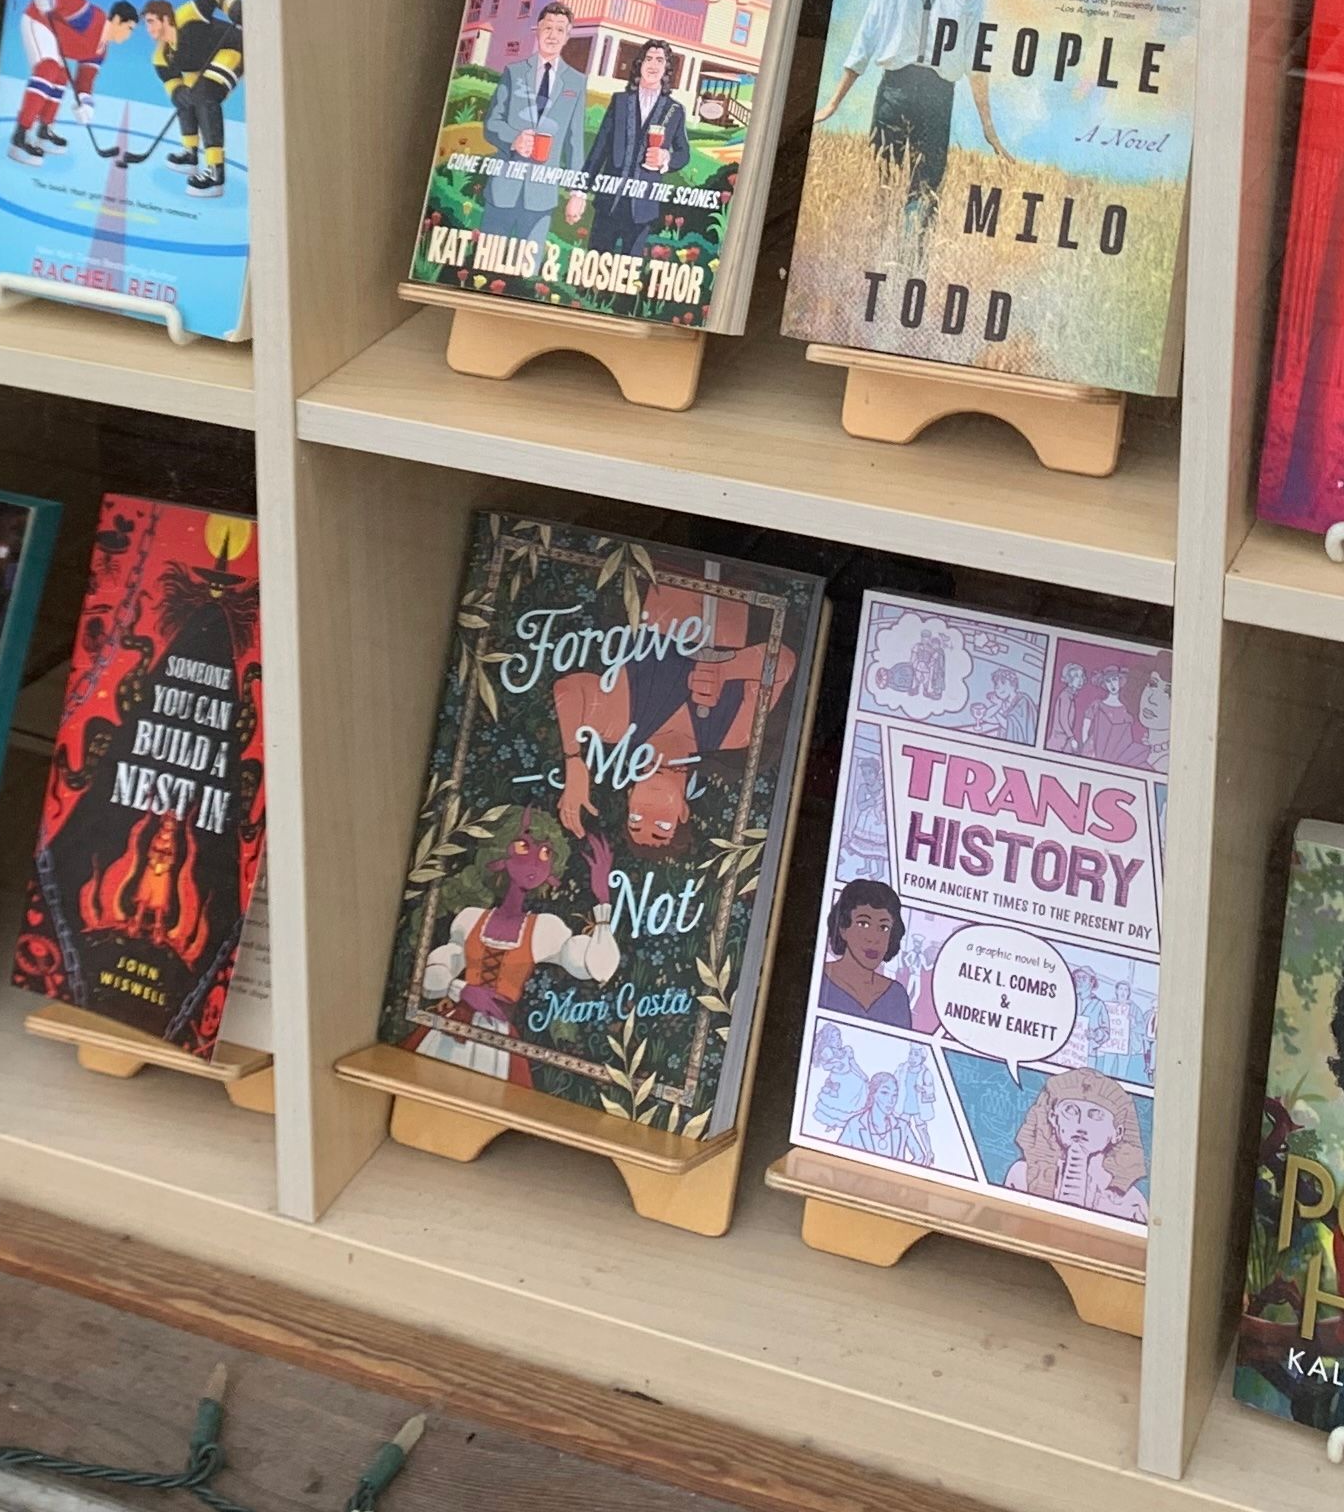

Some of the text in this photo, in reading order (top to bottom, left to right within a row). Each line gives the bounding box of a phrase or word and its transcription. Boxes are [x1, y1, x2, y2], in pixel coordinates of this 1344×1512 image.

[932, 17, 1166, 94] PEOPLE
[1075, 125, 1170, 155] A Novel
[447, 153, 720, 209] COME FOR THE VAMPIRES. STAY FOR THE SCONES.
[964, 184, 1128, 257] MILO
[427, 226, 704, 305] KAT HILLIS & ROSIEE THOR
[864, 271, 1013, 343] TODD
[165, 655, 231, 691] SOMEONE
[500, 604, 711, 694] Forgive
[155, 683, 232, 732] YOU CAN
[133, 719, 227, 779] BUILD A
[549, 725, 661, 791] Me
[110, 761, 230, 835] NEST IN
[901, 745, 1137, 841] TRANS
[905, 810, 1144, 907] HISTORY
[608, 870, 704, 939] Not
[904, 873, 1153, 940] FROM ANCIENT TIMES TO THE PRESENT DAY
[100, 971, 166, 1006] WISWELL
[116, 956, 160, 980] JOHN
[958, 963, 1057, 999] ALEX L. COMBS
[528, 982, 691, 1033] Mari Costa
[944, 1001, 1003, 1028] ANDREW
[1006, 1015, 1057, 1042] EAKETT
